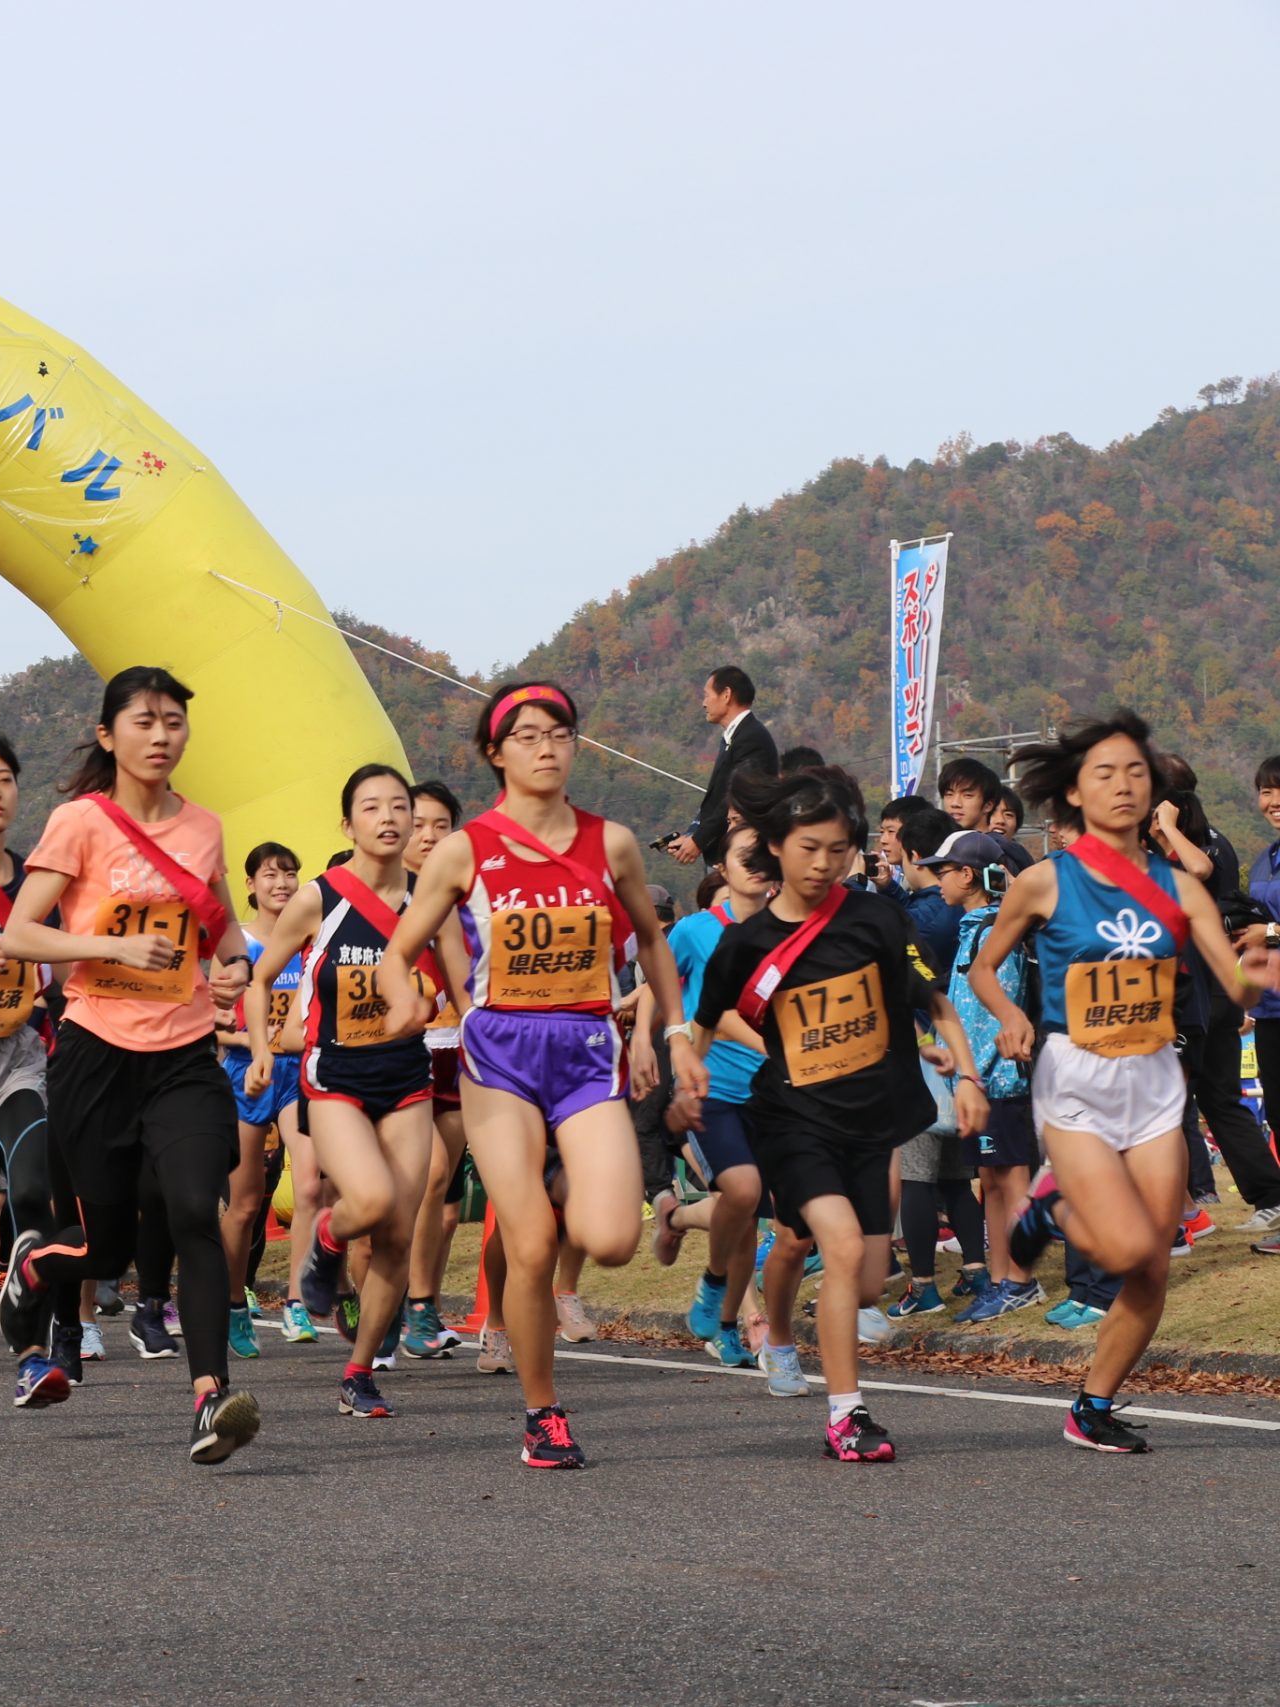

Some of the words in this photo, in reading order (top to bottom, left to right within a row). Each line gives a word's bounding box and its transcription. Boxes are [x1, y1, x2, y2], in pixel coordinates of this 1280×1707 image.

[107, 903, 190, 948] 31-1
[503, 910, 598, 952] 30-1
[507, 949, 597, 976] 県民共済
[1085, 962, 1160, 1003] 11-1
[501, 987, 552, 999] スポーツくじ
[789, 973, 873, 1028] 17-1
[800, 1010, 879, 1054] 県民共済
[1083, 1001, 1163, 1029] 県民共済
